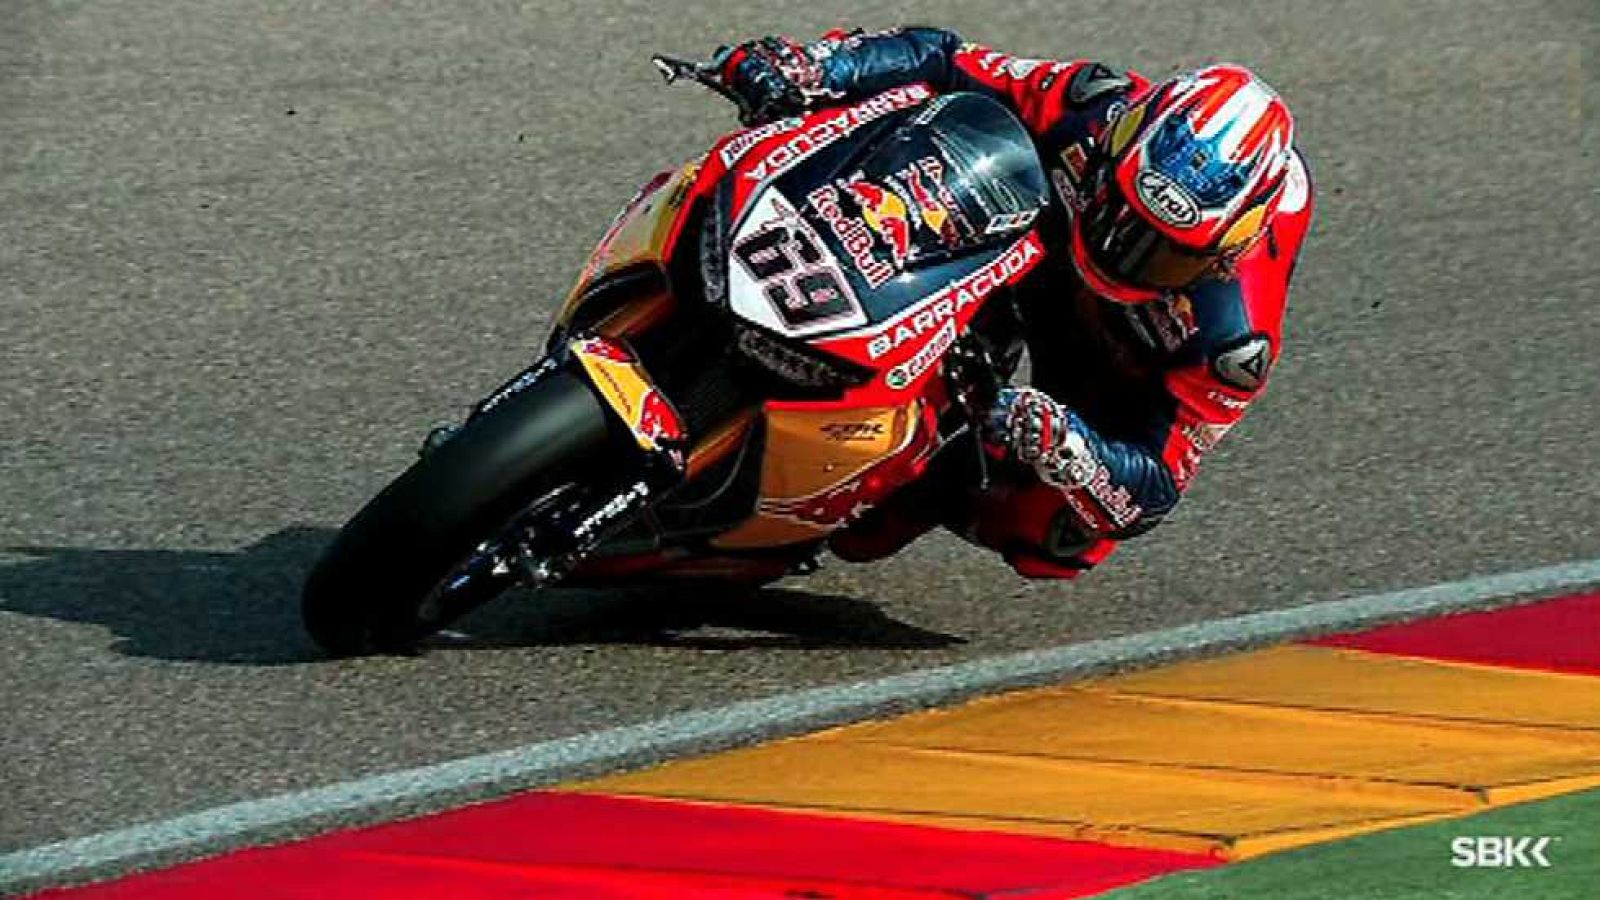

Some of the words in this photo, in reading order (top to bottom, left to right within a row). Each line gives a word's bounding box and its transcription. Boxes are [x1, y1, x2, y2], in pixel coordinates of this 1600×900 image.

[1142, 176, 1193, 221] Arai
[734, 220, 856, 331] 69
[867, 241, 1040, 360] BARRACUDA
